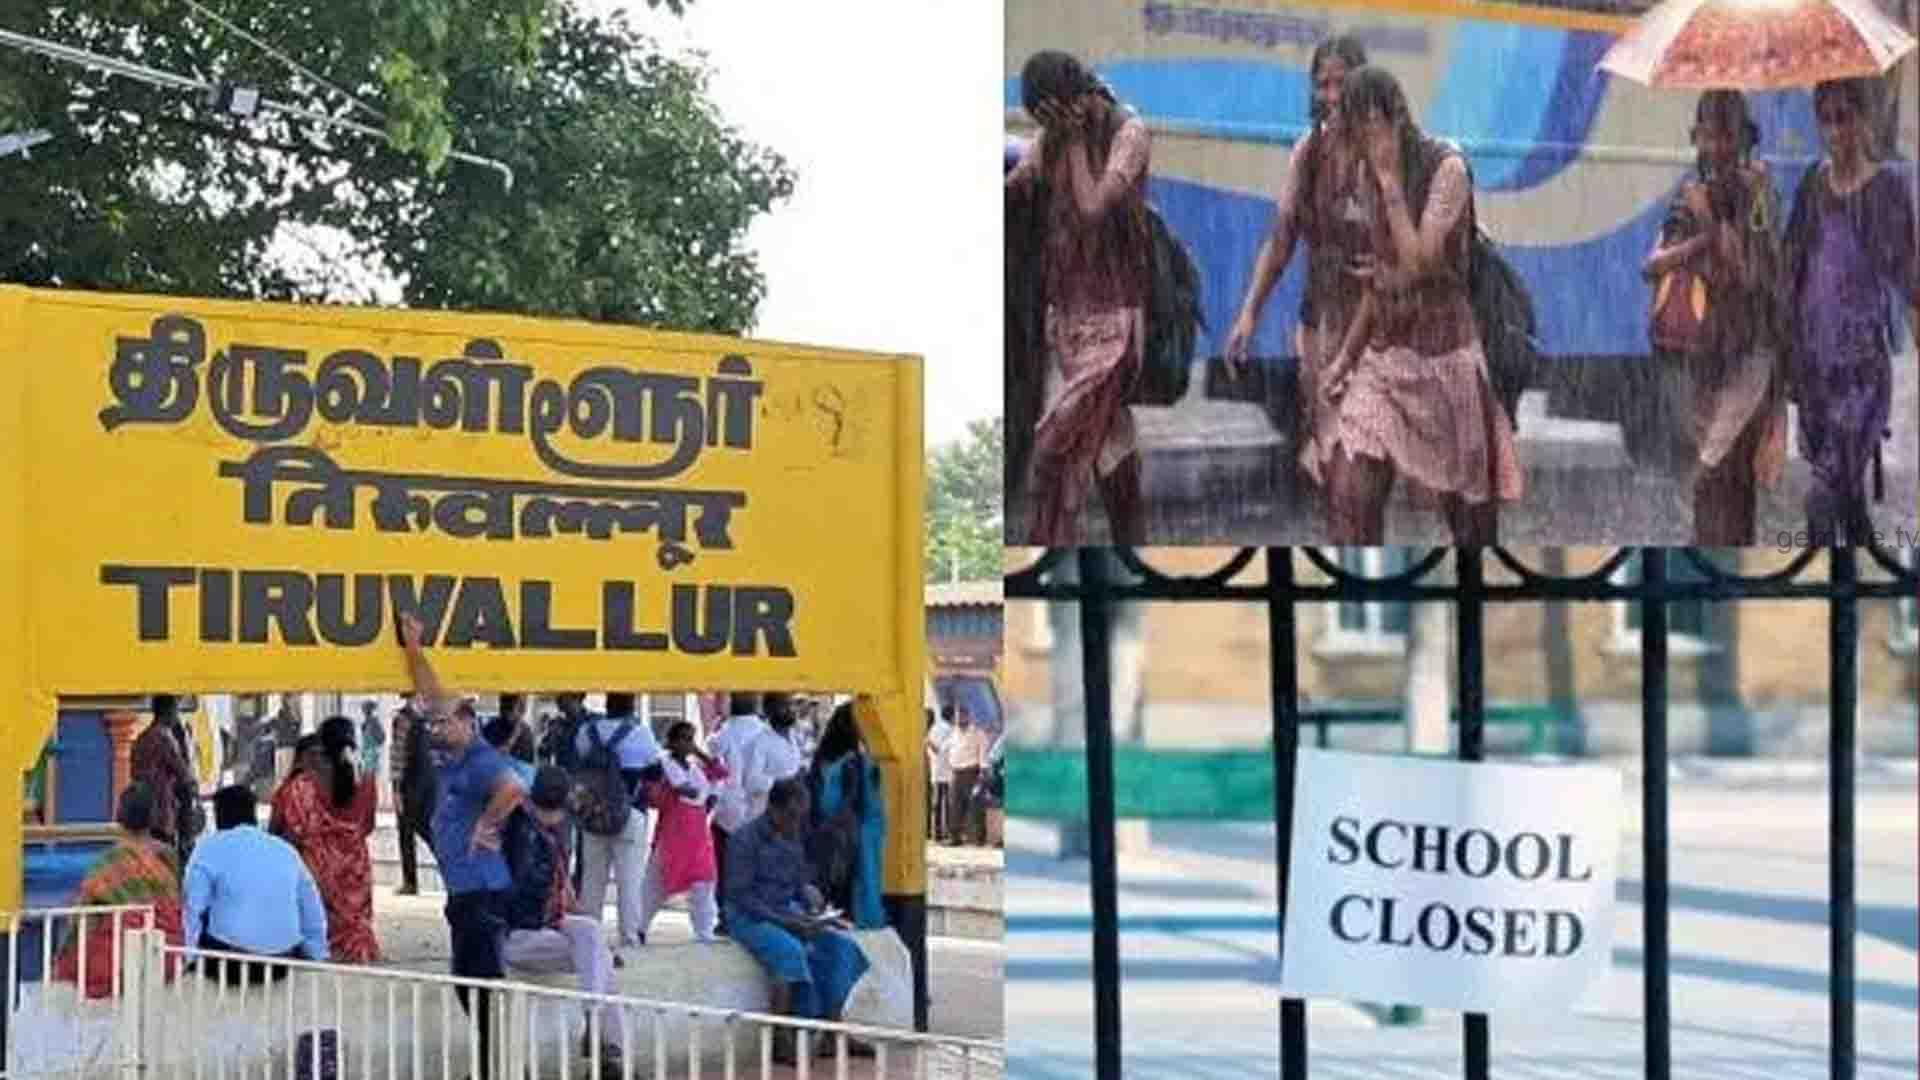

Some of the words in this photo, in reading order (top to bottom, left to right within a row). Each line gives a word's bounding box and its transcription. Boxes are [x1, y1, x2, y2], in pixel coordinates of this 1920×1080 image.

[100, 564, 796, 658] TIRUVALLUR
[1327, 816, 1592, 882] SCHOOL
[1329, 893, 1584, 957] CLOSED
